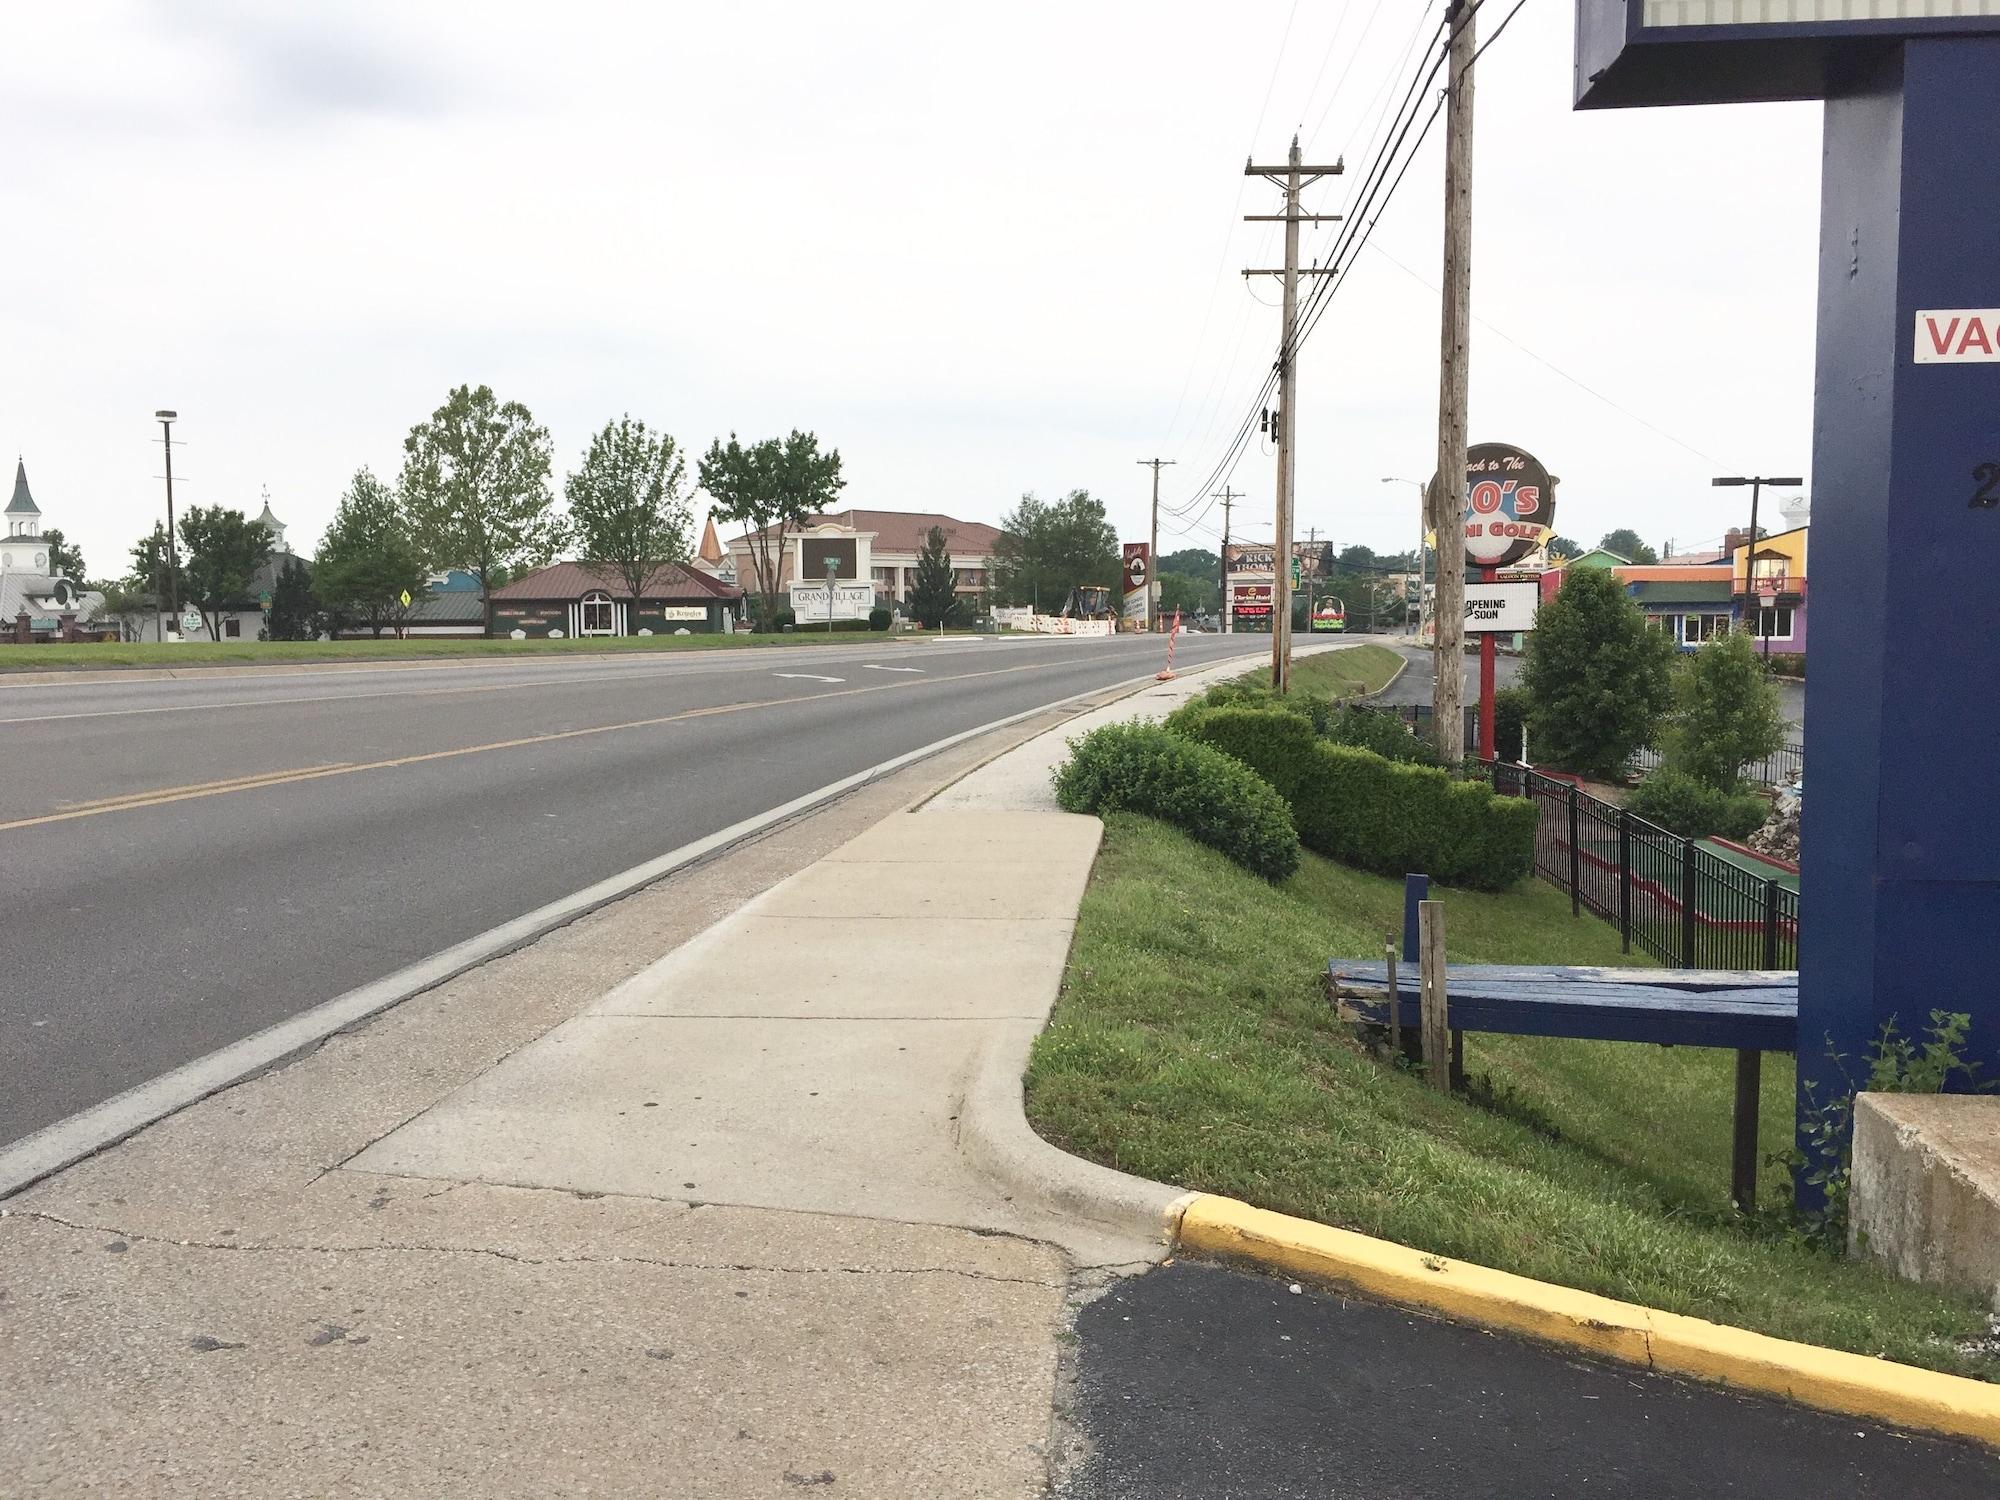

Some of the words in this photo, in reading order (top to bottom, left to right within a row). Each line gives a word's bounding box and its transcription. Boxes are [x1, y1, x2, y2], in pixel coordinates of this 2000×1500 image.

[1926, 317, 2000, 355] VA
[1466, 459, 1485, 472] ack
[1488, 460, 1499, 471] to
[1503, 456, 1525, 471] The
[1465, 524, 1483, 538] NI
[1489, 522, 1542, 539] GOLF
[1246, 553, 1273, 563] RICK
[1235, 564, 1275, 572] THOMA
[798, 592, 829, 601] GRAND
[1474, 609, 1498, 619] SOON
